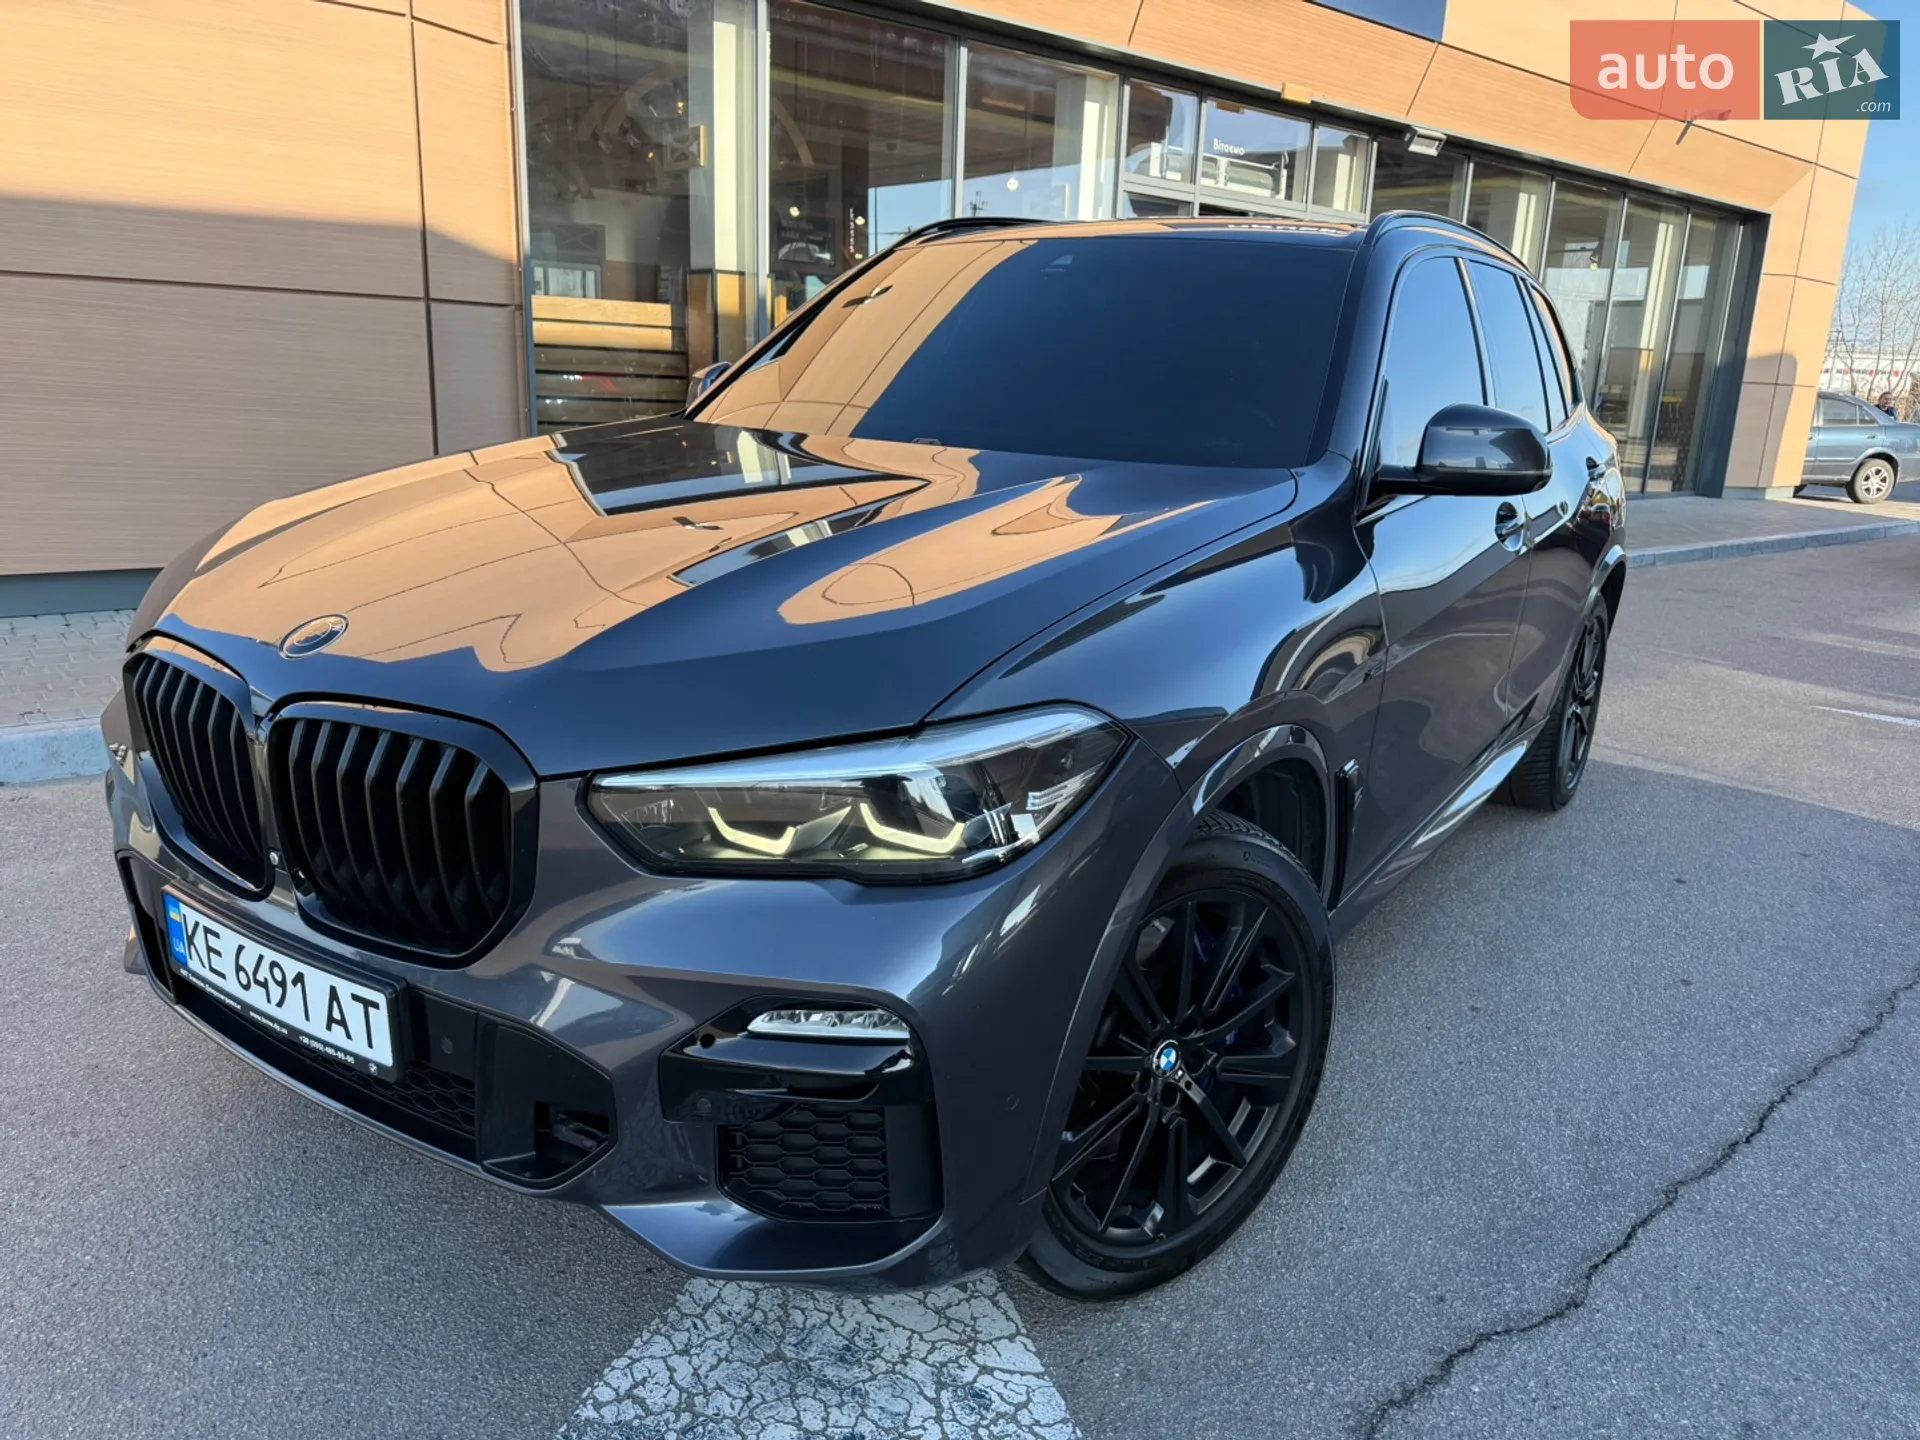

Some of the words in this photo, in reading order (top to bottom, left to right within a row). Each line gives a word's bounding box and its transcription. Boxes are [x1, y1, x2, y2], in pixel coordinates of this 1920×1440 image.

[173, 937, 186, 956] UA
[182, 913, 227, 981] KE
[235, 944, 310, 1022] 6491
[325, 985, 380, 1050] AT
